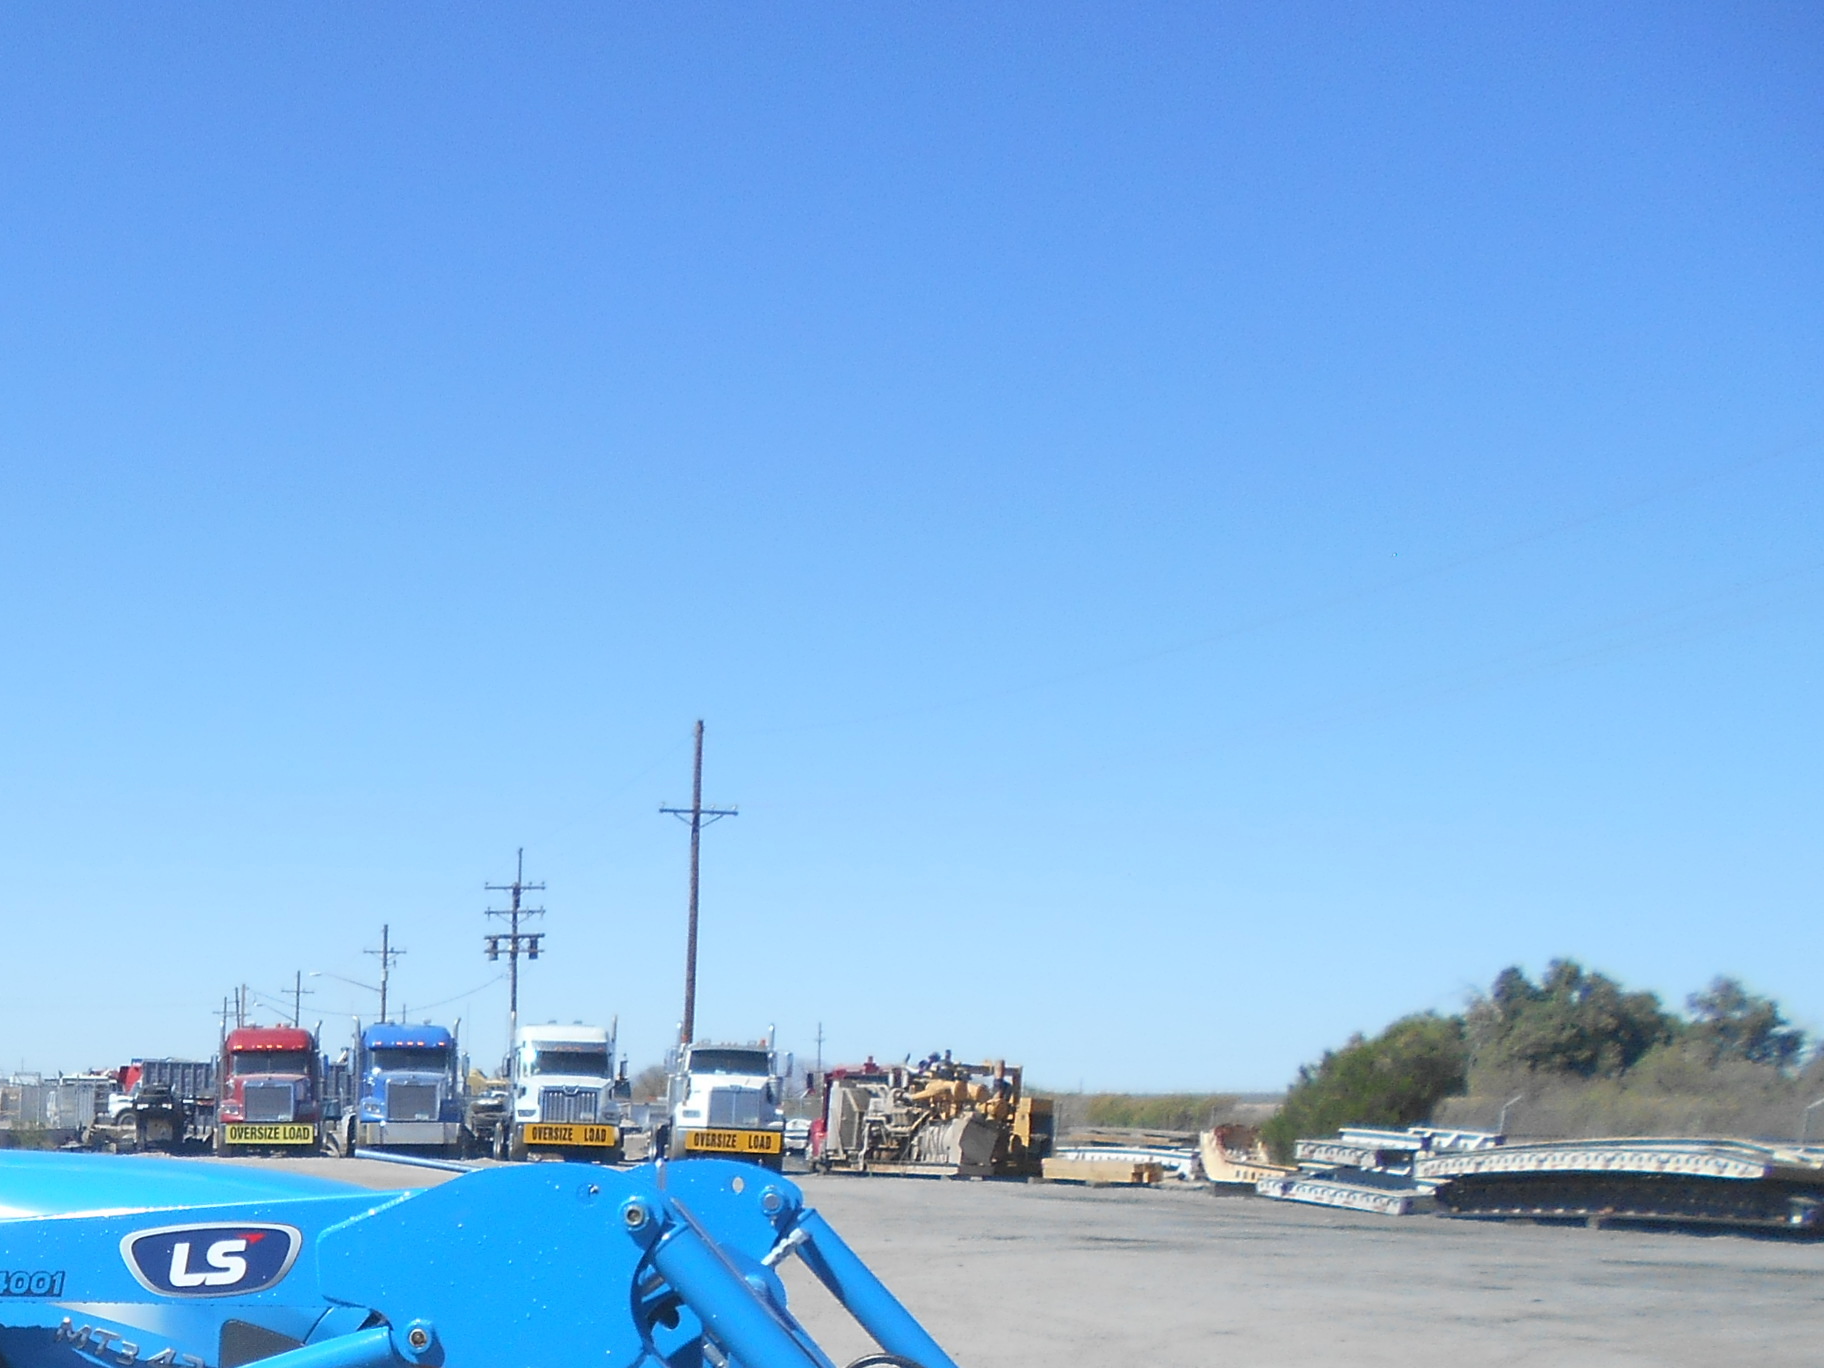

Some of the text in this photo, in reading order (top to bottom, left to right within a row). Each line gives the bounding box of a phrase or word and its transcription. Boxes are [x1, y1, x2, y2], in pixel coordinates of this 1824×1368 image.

[230, 1126, 310, 1140] OVERSIZE LOAD
[532, 1127, 607, 1142] OVERSIZE LOAD
[694, 1132, 772, 1150] OVERSIZE LOAD
[169, 1239, 247, 1287] LS
